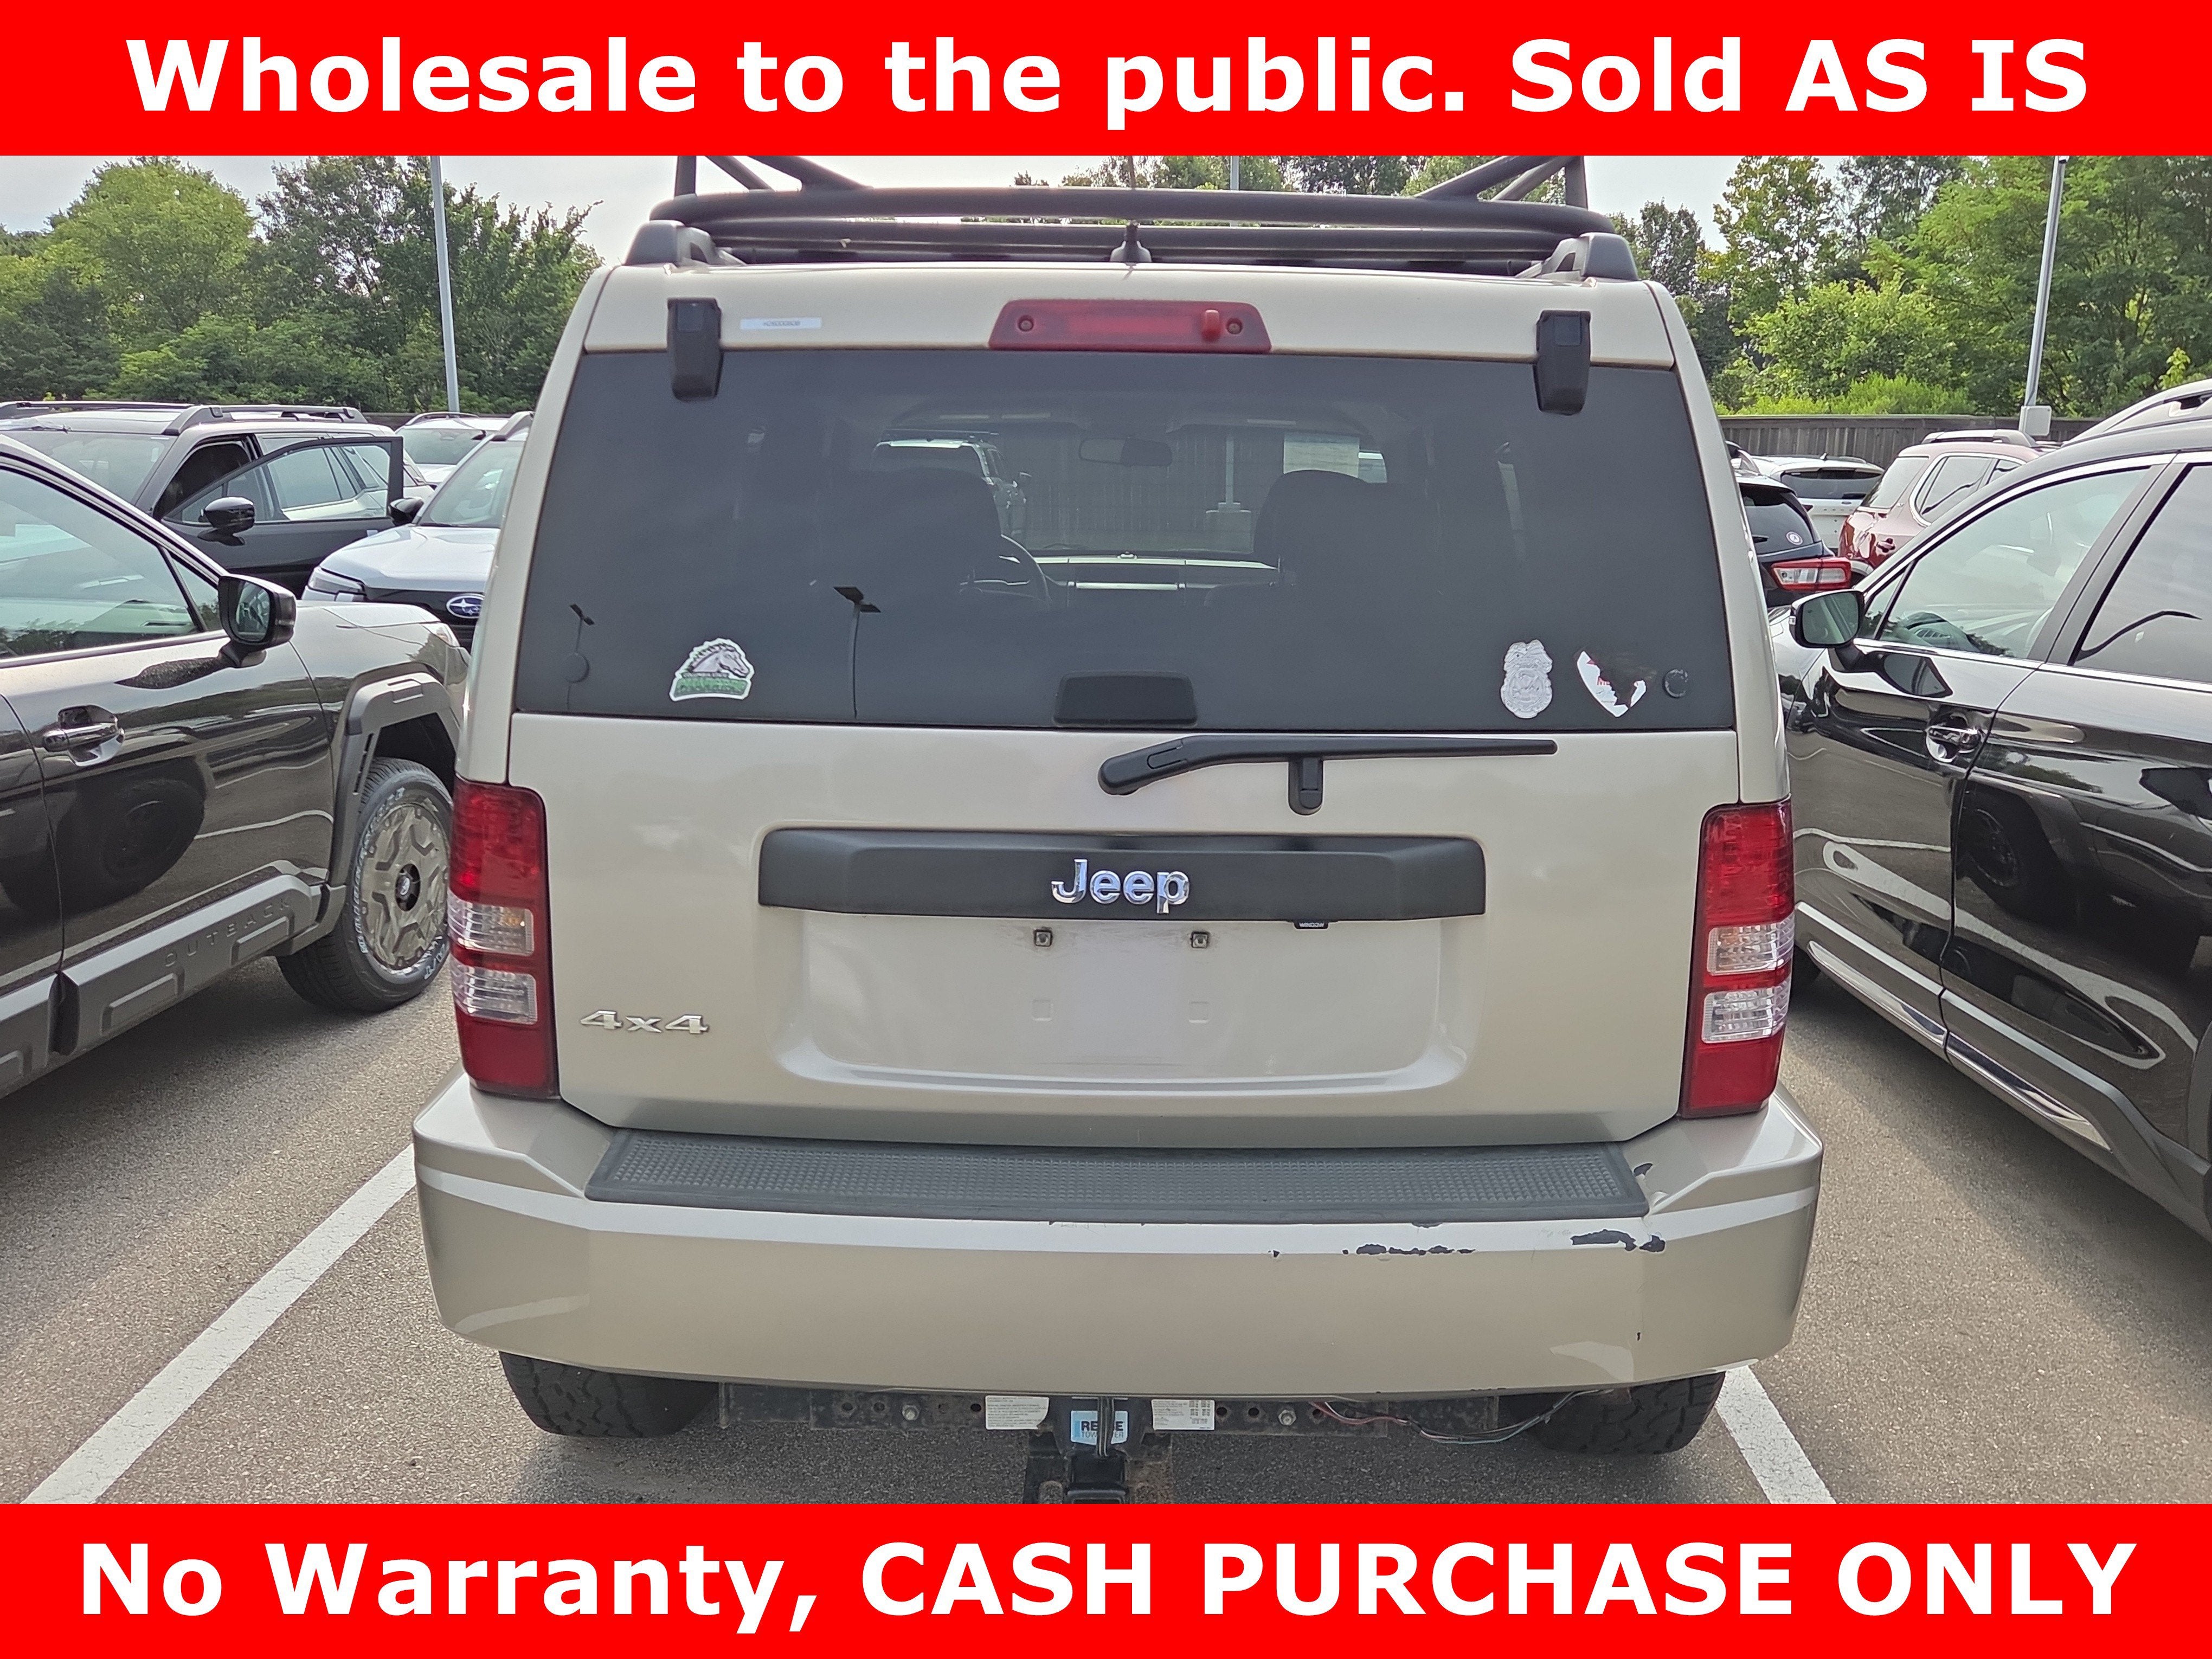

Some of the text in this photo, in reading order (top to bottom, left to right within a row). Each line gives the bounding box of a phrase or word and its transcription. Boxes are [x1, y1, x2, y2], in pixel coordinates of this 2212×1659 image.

[1051, 859, 1189, 914] Jeep
[164, 897, 290, 968] OUTBACK
[580, 1009, 710, 1034] 4x4
[1081, 1420, 1124, 1431] REE
